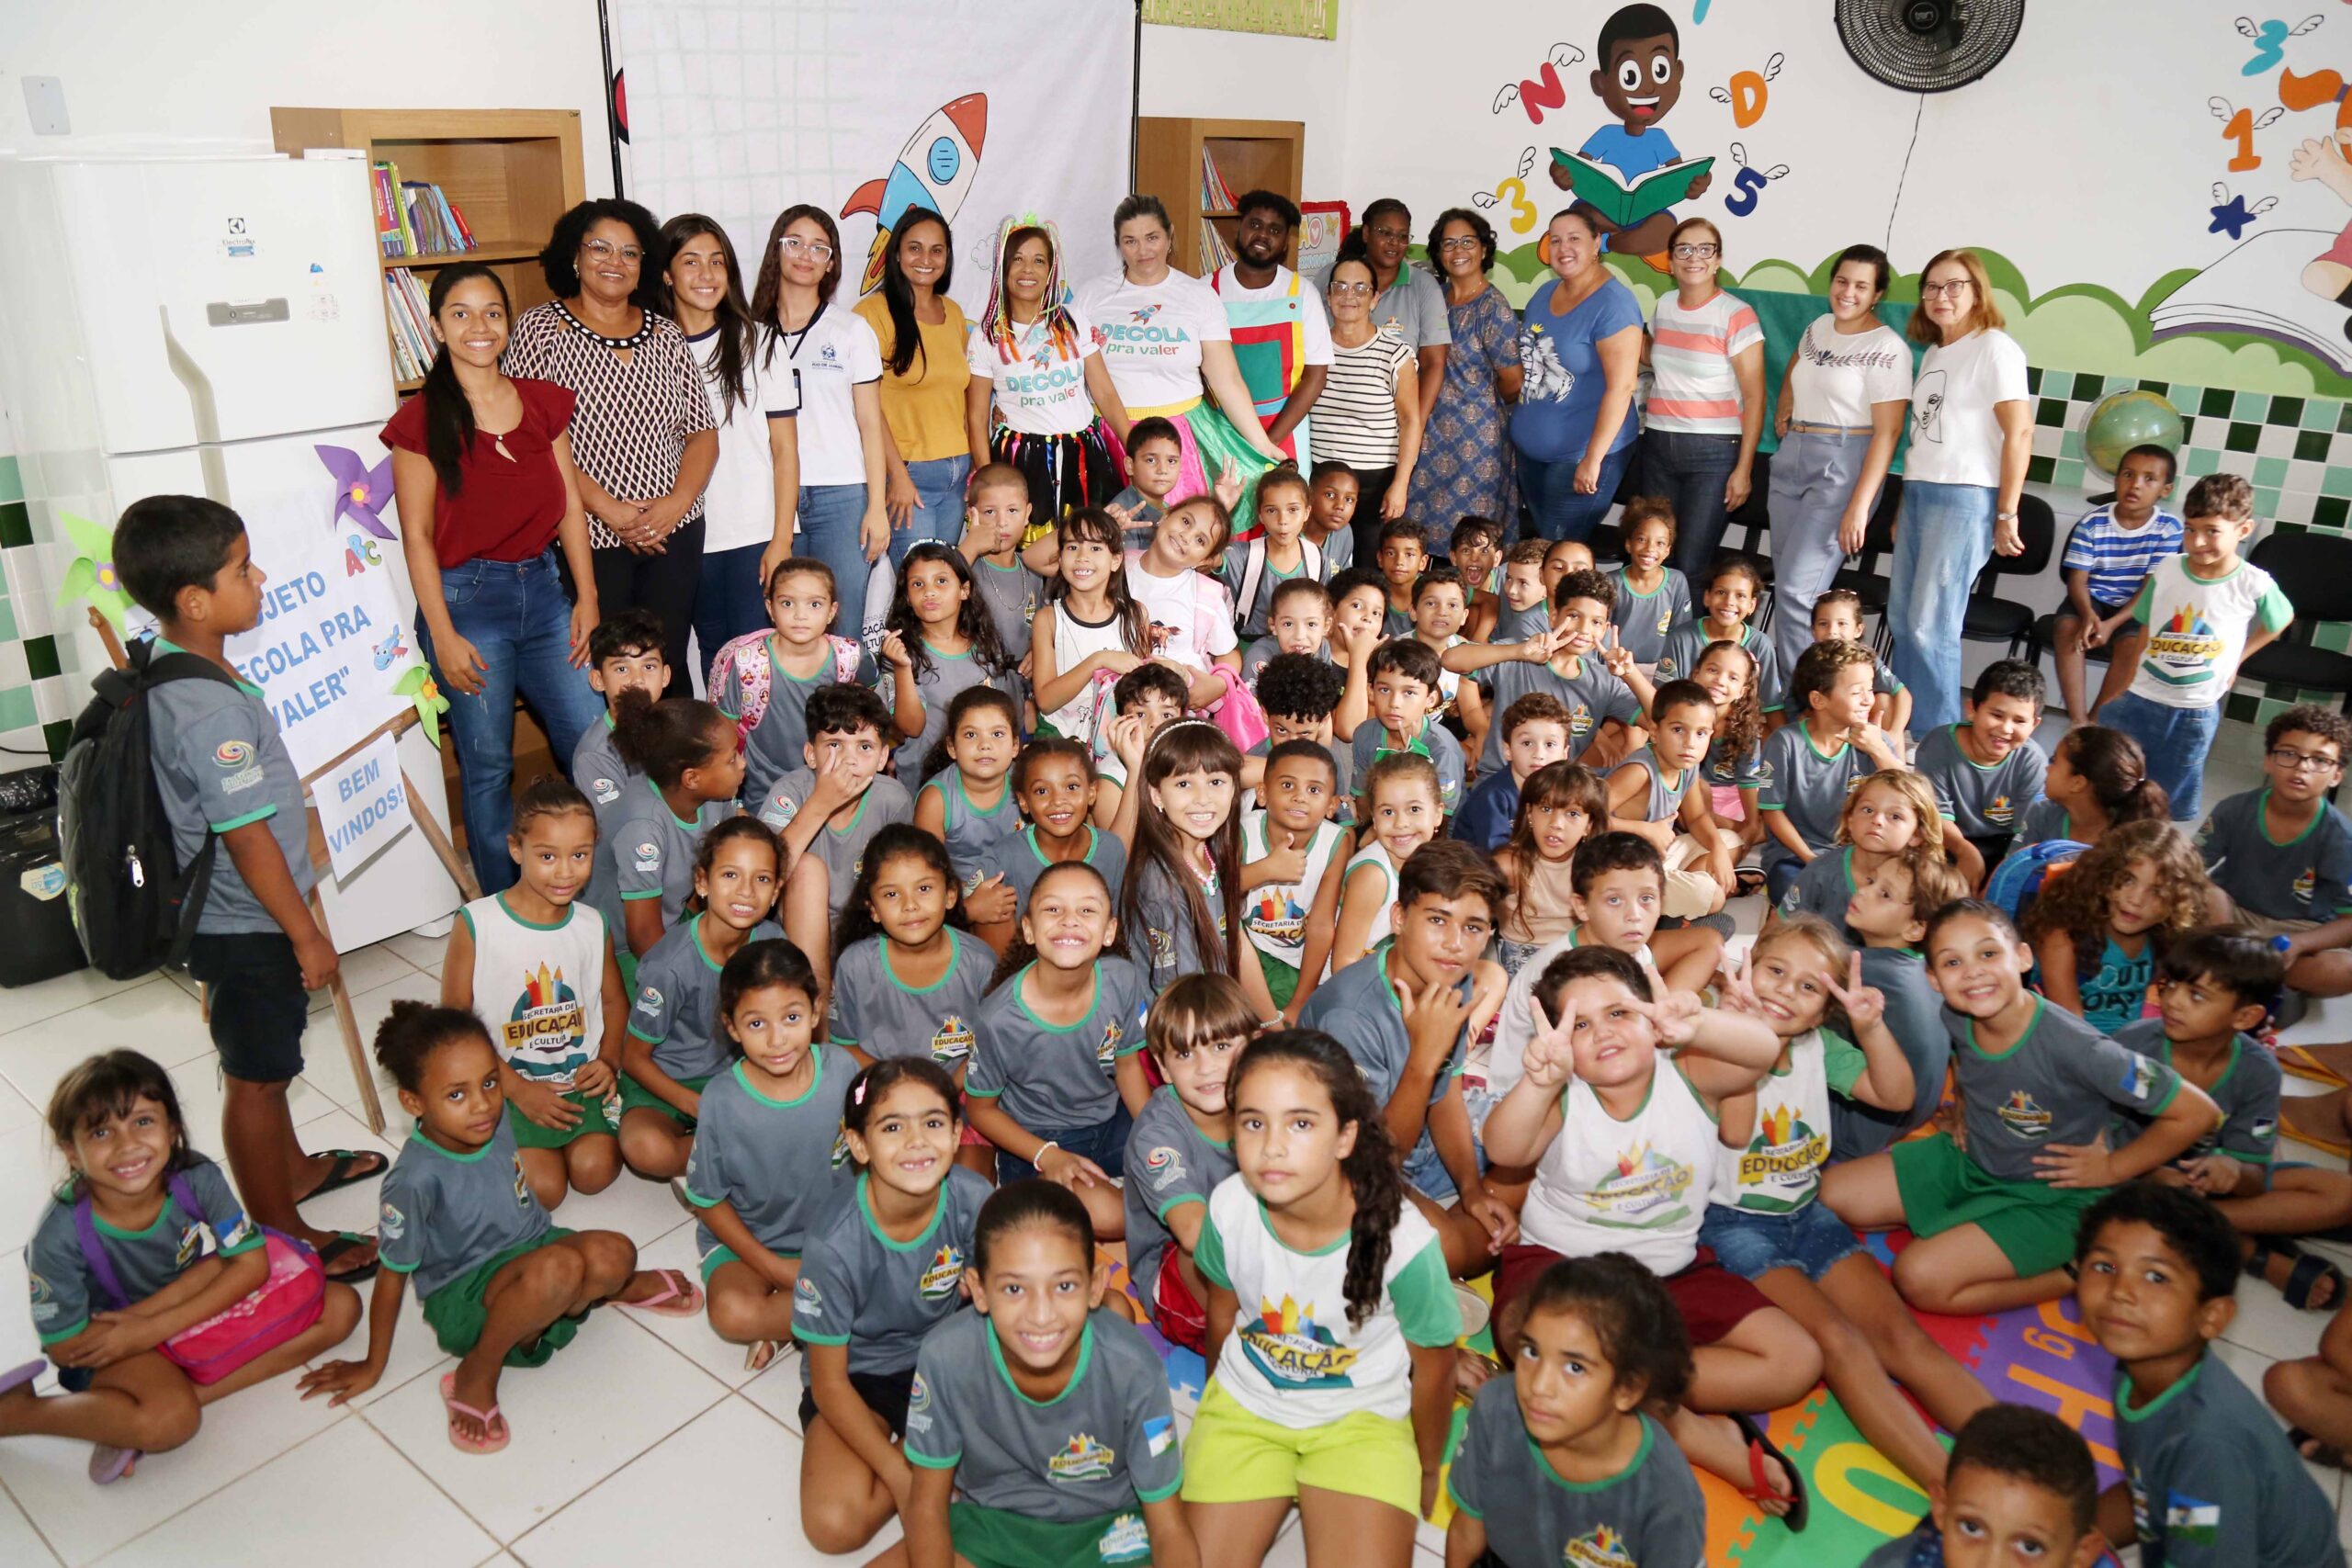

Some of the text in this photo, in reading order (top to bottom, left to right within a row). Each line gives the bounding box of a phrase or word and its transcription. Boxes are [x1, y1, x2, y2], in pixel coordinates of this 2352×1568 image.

[1520, 62, 1566, 125] N
[1730, 71, 1768, 128] D
[2222, 108, 2262, 172] 1
[1724, 167, 1768, 217] 5
[1105, 342, 1180, 355] pra valer
[1020, 395, 1046, 408] pra
[319, 604, 372, 648] PRA
[862, 618, 886, 637] CAÇÃ
[2151, 639, 2222, 654] DUCAÇÃO
[338, 758, 380, 804] BEM
[328, 784, 404, 854] VINDOS!
[1253, 919, 1295, 929] SECRETARIA
[564, 1002, 575, 1011] DE
